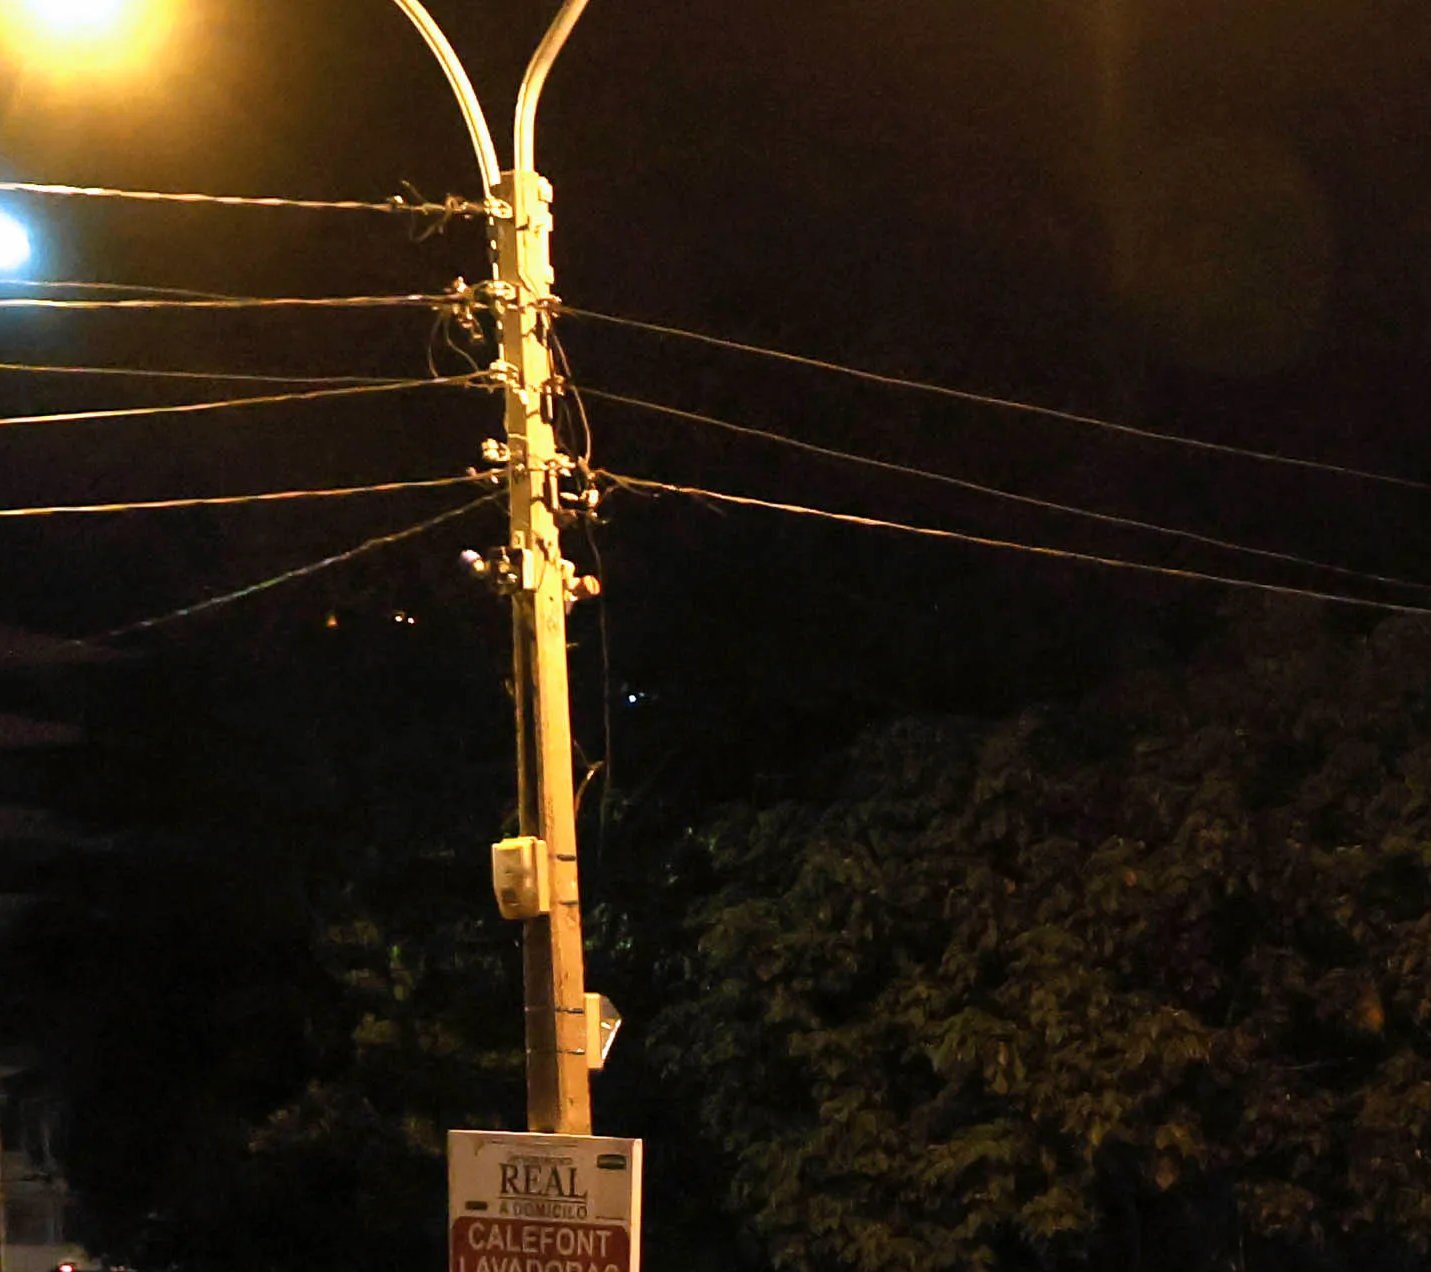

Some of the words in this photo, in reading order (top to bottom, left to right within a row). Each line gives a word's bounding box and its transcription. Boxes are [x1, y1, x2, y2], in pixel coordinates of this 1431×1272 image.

[499, 1162, 588, 1197] REAL
[499, 1200, 509, 1214] A
[468, 1221, 612, 1258] CALEFONT
